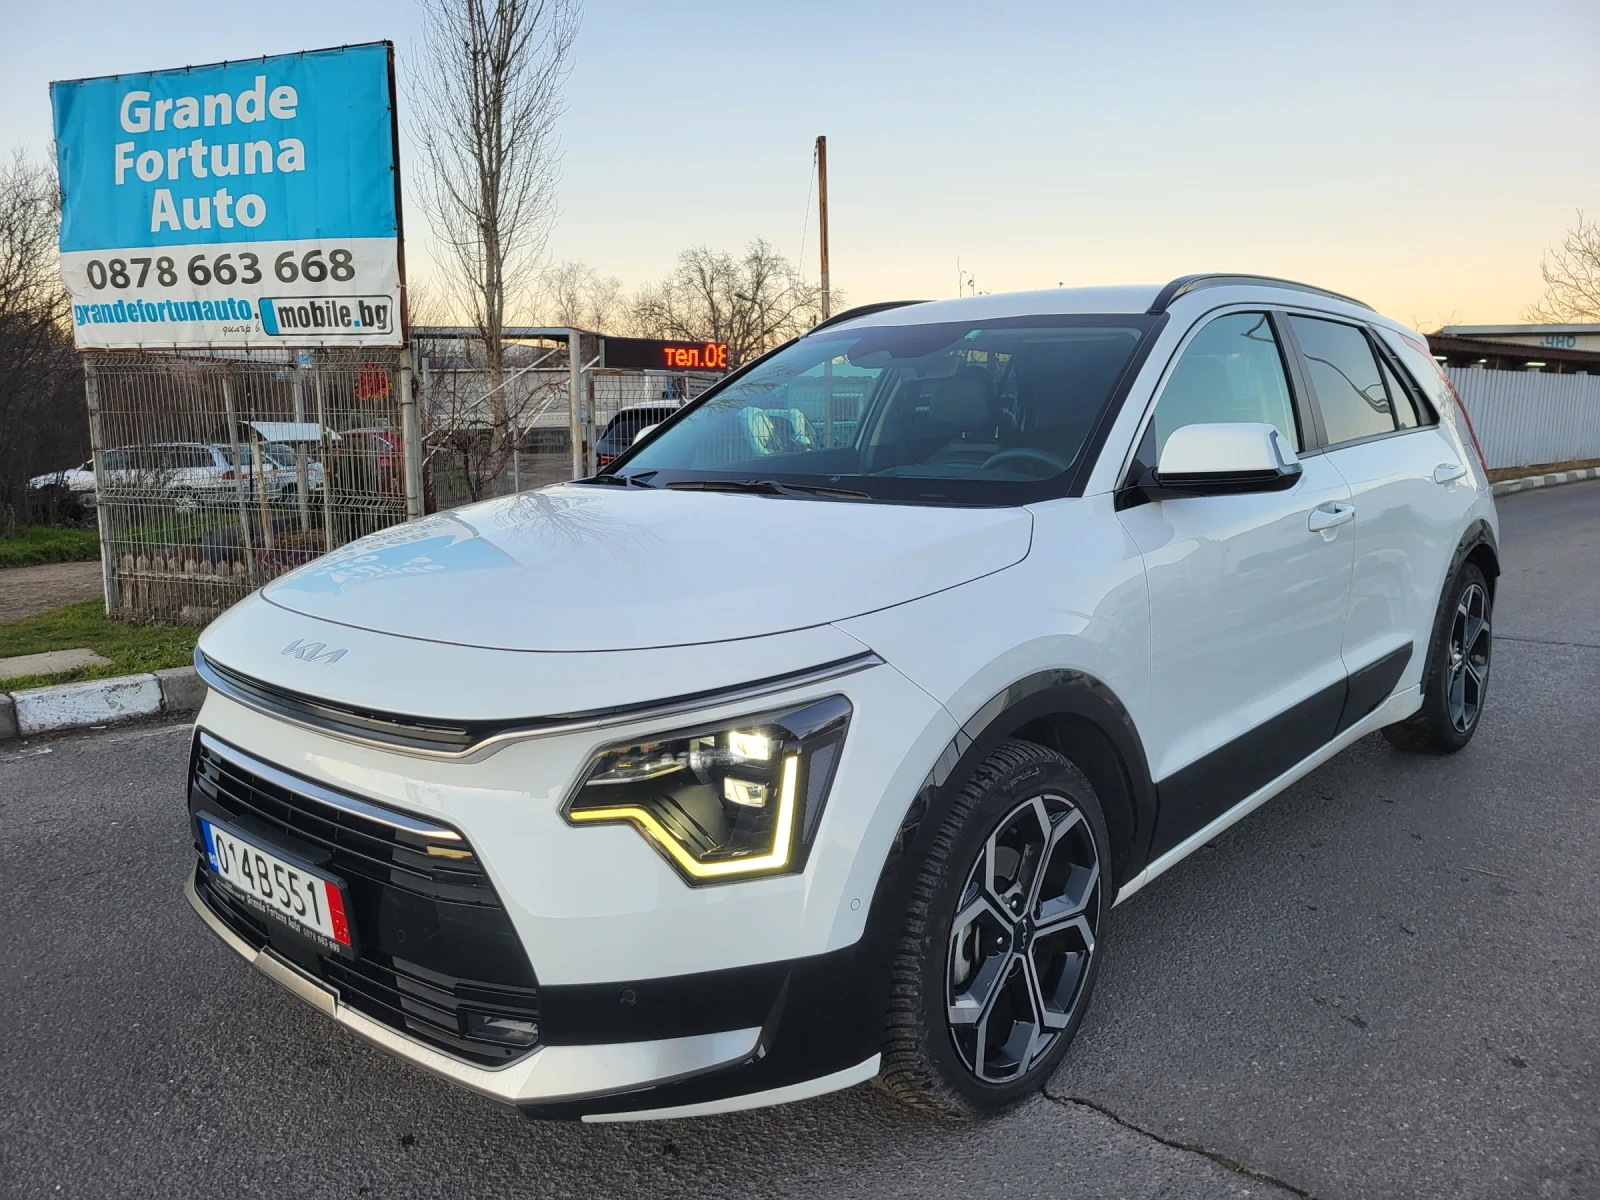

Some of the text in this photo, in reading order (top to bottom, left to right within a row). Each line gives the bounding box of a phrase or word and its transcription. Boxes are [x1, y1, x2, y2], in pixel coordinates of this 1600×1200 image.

[120, 76, 298, 133] Grande
[114, 138, 306, 186] Fortuna
[150, 187, 267, 233] Auto
[86, 248, 356, 290] 0878 663 668
[278, 301, 388, 330] mobile.bg
[280, 638, 349, 666] KIA
[215, 833, 321, 925] 014B551
